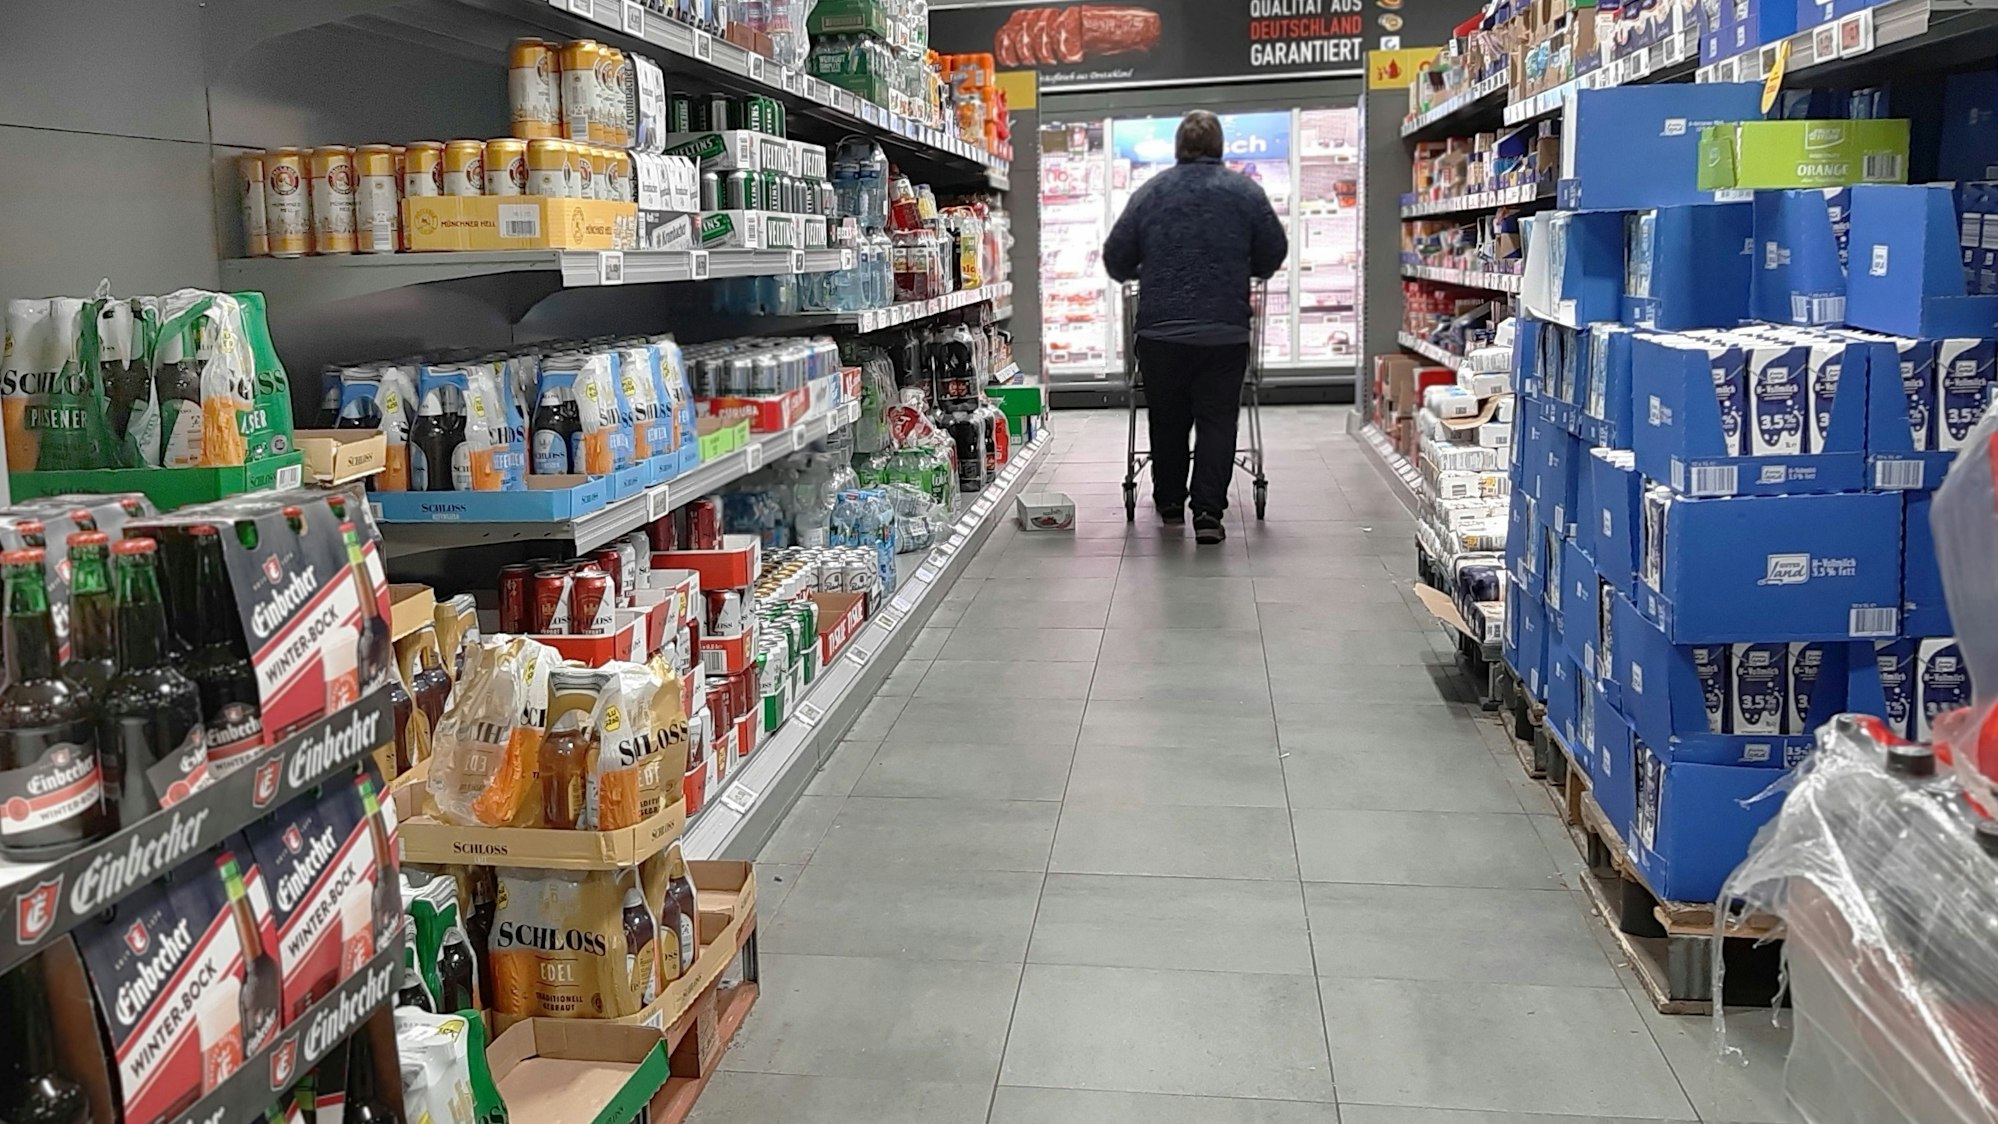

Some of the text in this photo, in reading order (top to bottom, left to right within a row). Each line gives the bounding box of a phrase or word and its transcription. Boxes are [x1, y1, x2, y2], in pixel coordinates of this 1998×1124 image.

[1331, 0, 1363, 12] AUS
[1250, 16, 1363, 40] DEUTSCHLAND
[1250, 38, 1363, 66] GARANTIERT
[752, 104, 760, 131] LTINS
[762, 142, 789, 172] VELTINS
[804, 150, 827, 178] VELTINS
[1797, 163, 1849, 177] ORANGE
[440, 218, 496, 229] MÜNCHNER HELL
[661, 222, 687, 246] Krombacher
[767, 220, 794, 246] VELTINS
[806, 222, 826, 246] VELTINS
[31, 408, 87, 429] PILSENER
[347, 452, 374, 466] SCHLOSS
[421, 503, 467, 513] SCHLOSS
[264, 603, 340, 685] WINTER-BOCK
[453, 841, 509, 855] SCHLOSS
[287, 861, 357, 958] WINTER-BOCK
[497, 921, 607, 956] SCHLOSS
[540, 962, 575, 983] EDEL
[536, 991, 584, 1004] TRADITIONELL
[130, 957, 218, 1079] WINTER-BOCK
